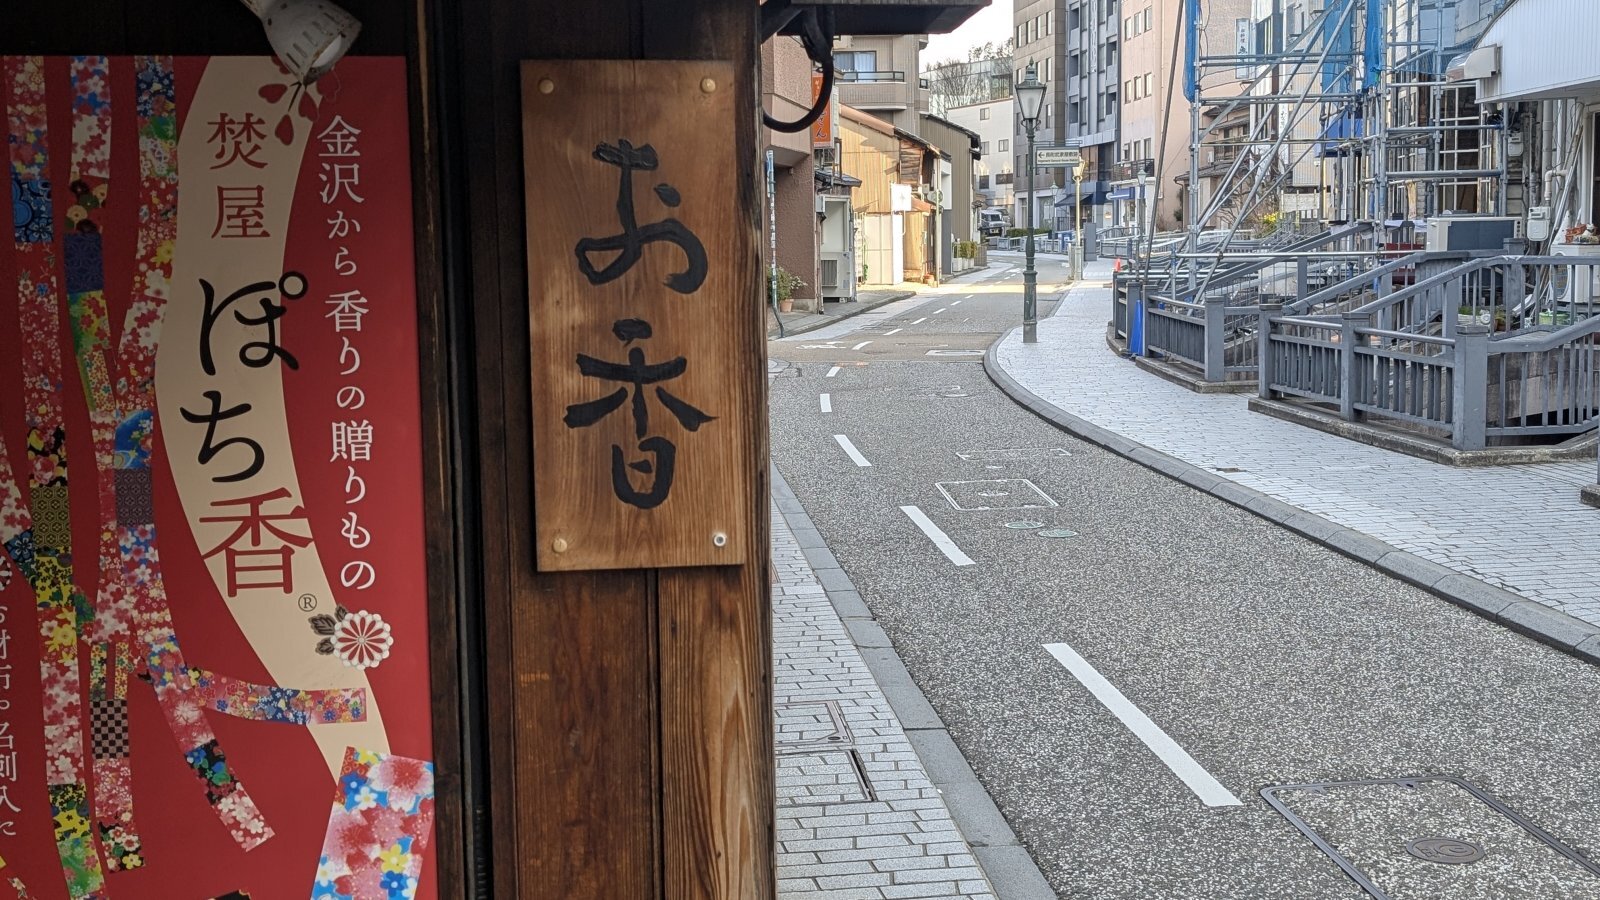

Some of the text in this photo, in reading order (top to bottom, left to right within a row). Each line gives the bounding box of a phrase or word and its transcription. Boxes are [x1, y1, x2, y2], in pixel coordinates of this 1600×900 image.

[206, 112, 271, 239] 焚屋
[316, 114, 377, 590] 金沢から香りの贈りもの
[562, 138, 720, 510] お香
